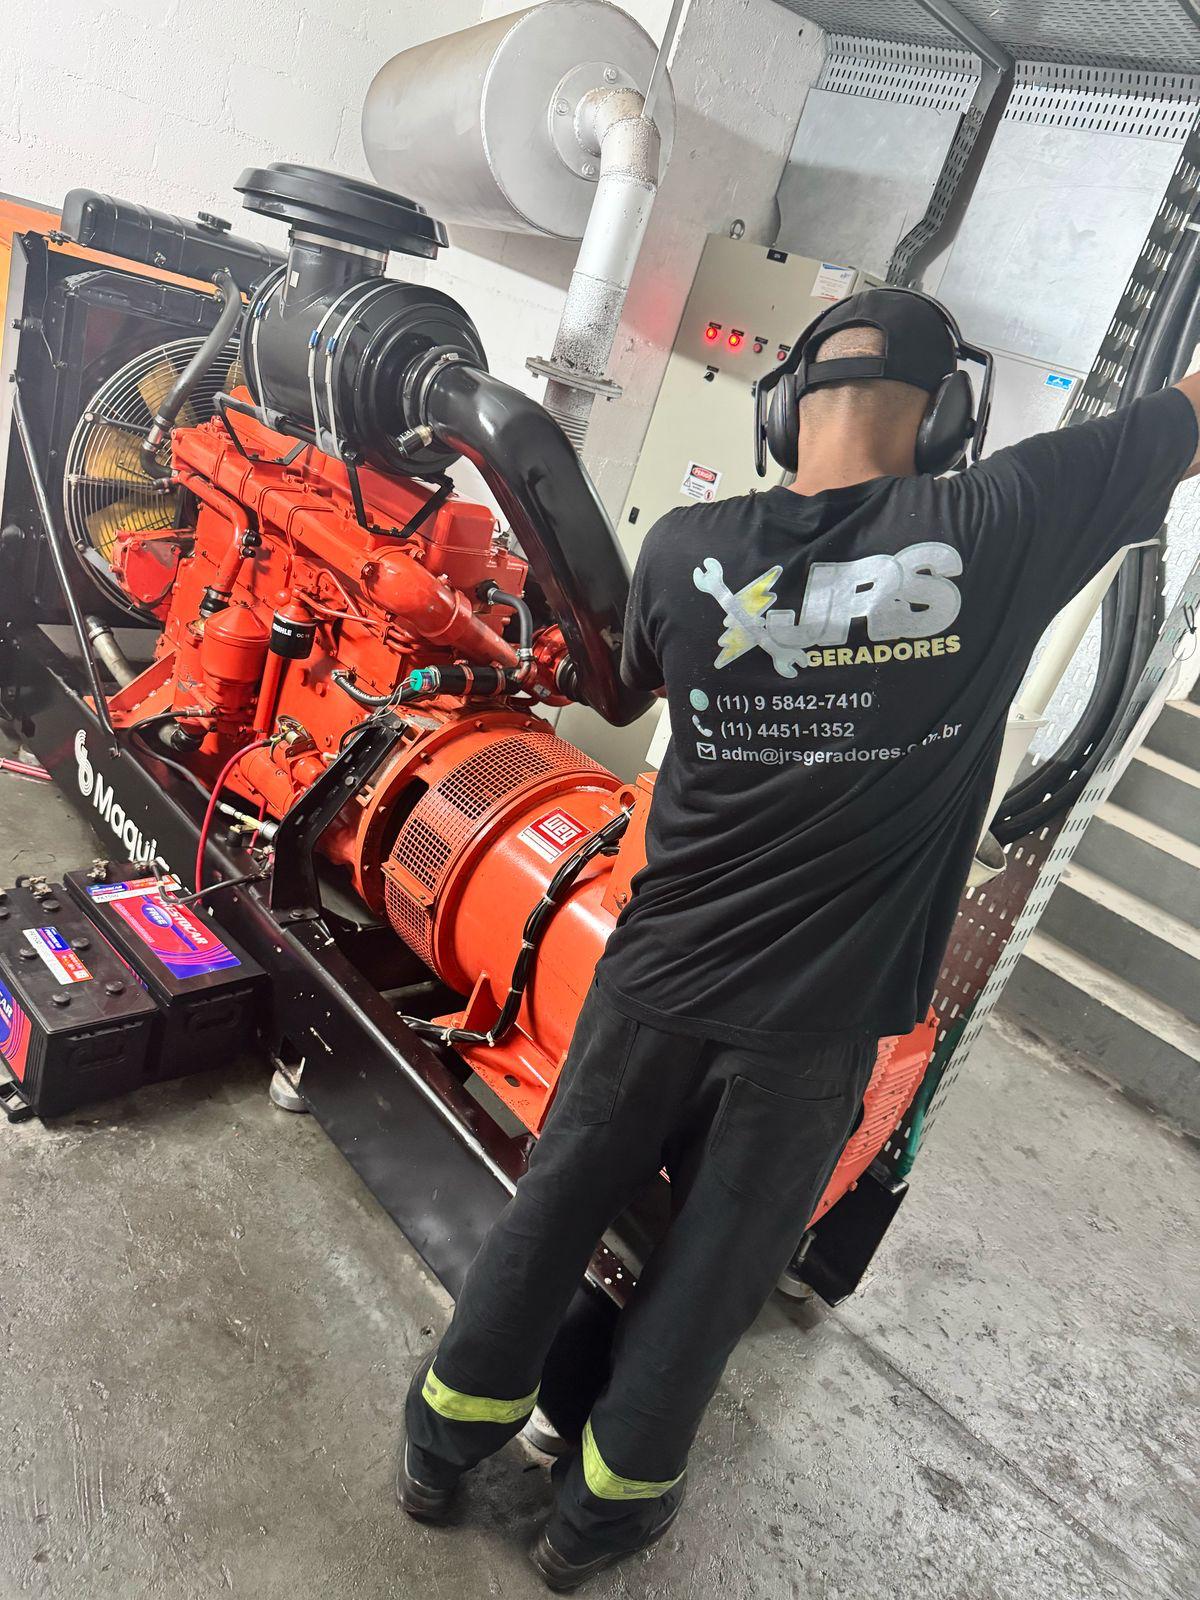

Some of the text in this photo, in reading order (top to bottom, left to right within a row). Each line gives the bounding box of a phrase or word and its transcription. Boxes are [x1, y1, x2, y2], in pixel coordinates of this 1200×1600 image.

[806, 635, 961, 667] GERADORES
[716, 692, 872, 713] (11) 9 5842-7410
[720, 721, 855, 741] (11) 4451-1352
[721, 724, 962, 766] adm@jrsgeradores.cm.br
[145, 907, 168, 924] FREE
